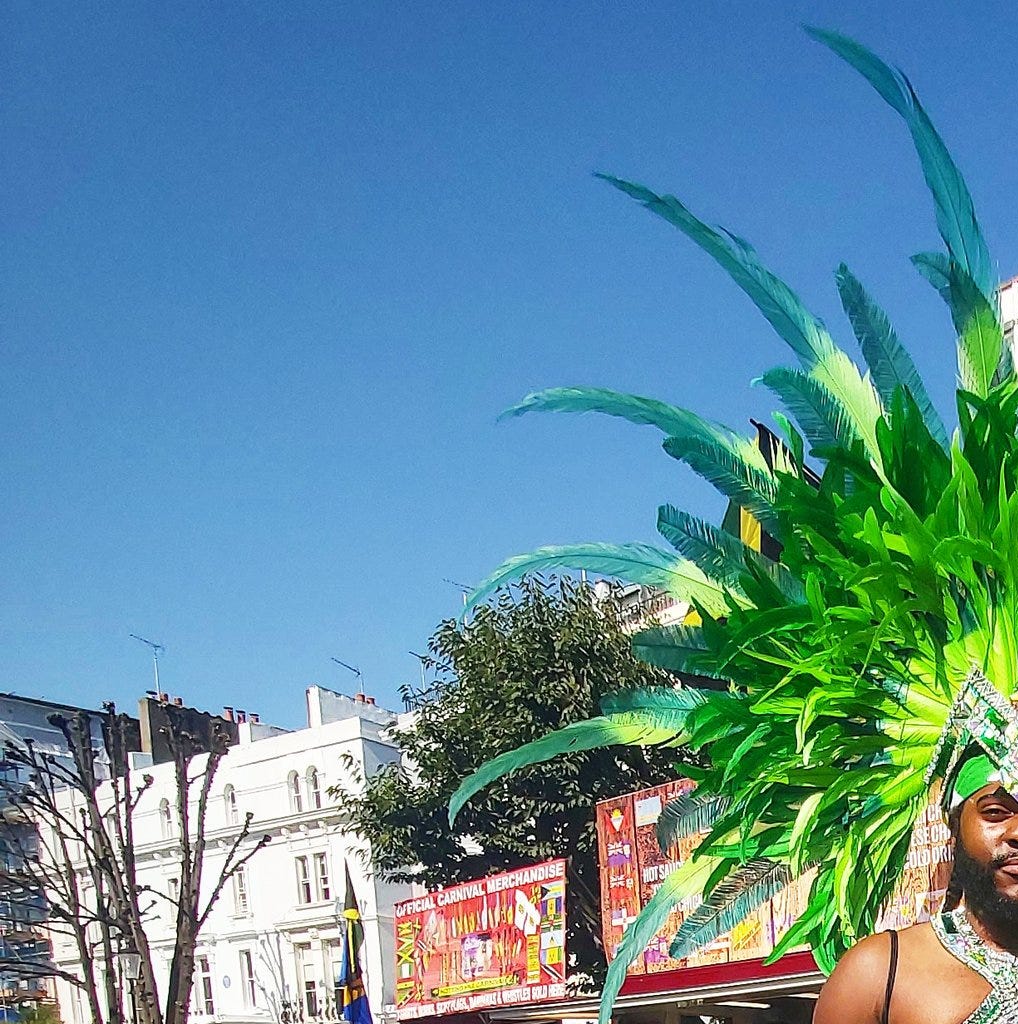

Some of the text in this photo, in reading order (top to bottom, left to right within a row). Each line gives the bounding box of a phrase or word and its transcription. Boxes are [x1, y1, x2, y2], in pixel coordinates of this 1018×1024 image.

[396, 864, 564, 917] OFFICIAL CARNIVAL MERCHANDISE
[643, 865, 659, 883] HOT
